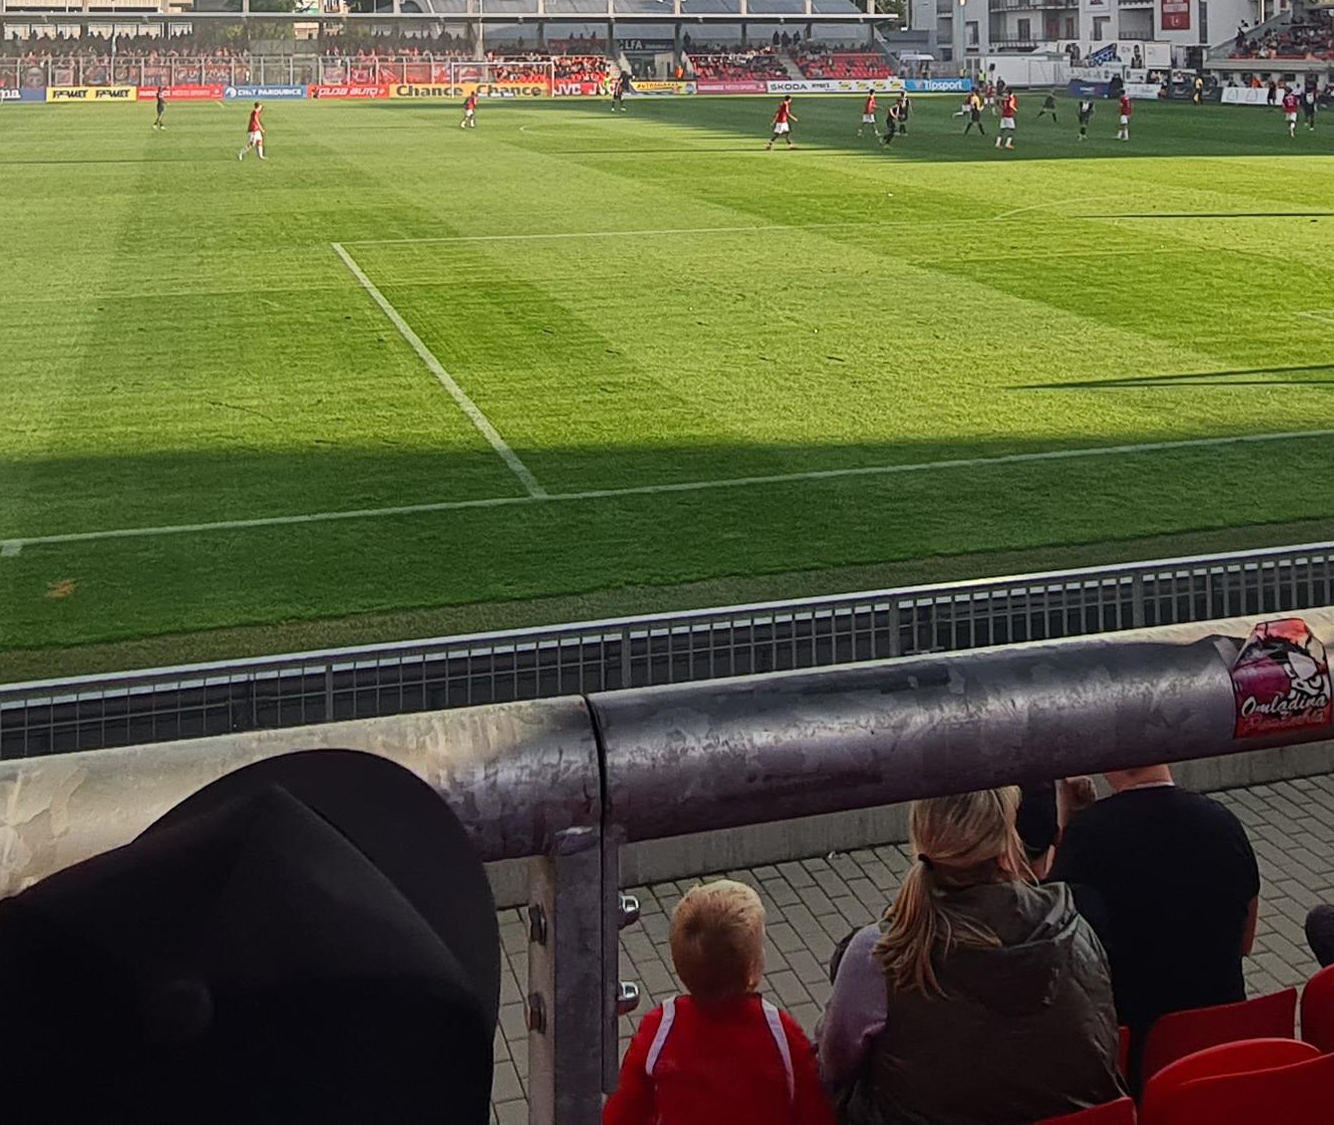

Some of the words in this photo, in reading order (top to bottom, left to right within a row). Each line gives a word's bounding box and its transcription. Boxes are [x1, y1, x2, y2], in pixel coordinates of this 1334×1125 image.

[396, 85, 464, 97] Chance
[476, 85, 541, 97] Chance
[553, 83, 582, 96] JVC
[924, 79, 964, 91] Tipsport
[258, 88, 302, 97] PARDUBICE
[1242, 691, 1327, 718] Omladina
